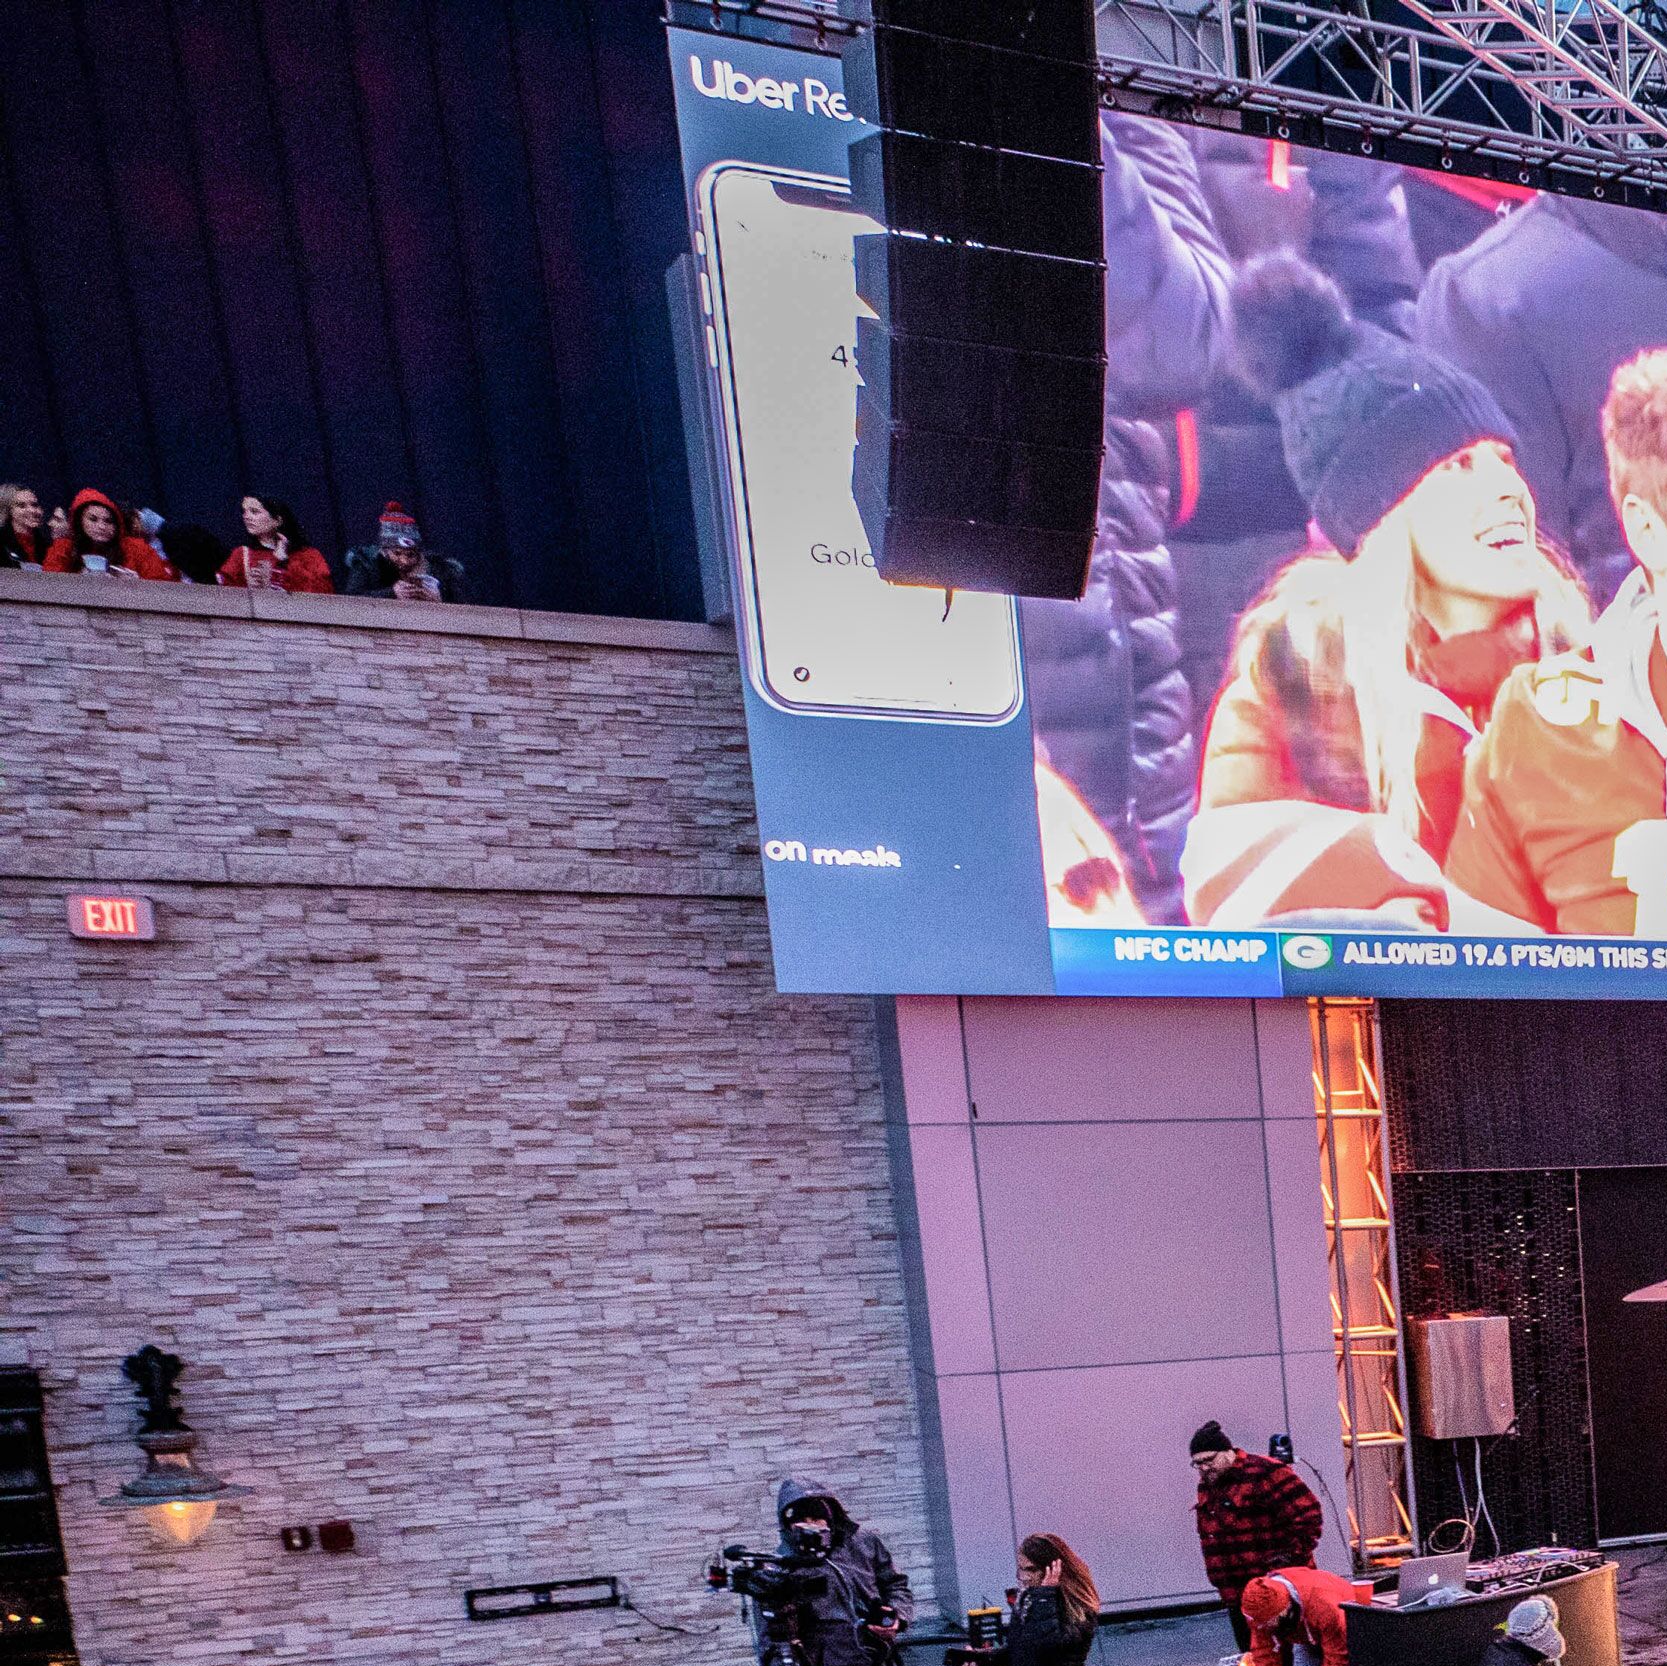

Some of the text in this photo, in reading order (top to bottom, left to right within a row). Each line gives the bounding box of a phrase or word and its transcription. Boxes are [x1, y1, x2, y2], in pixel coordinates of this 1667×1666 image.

[690, 55, 863, 123] Uber Re
[764, 840, 901, 868] on meals
[84, 900, 136, 932] EXIT
[1114, 936, 1267, 963] NFC CHAMP
[1343, 942, 1457, 966] ALLOWED
[1462, 943, 1507, 967] 19.6
[1599, 947, 1648, 969] THIS
